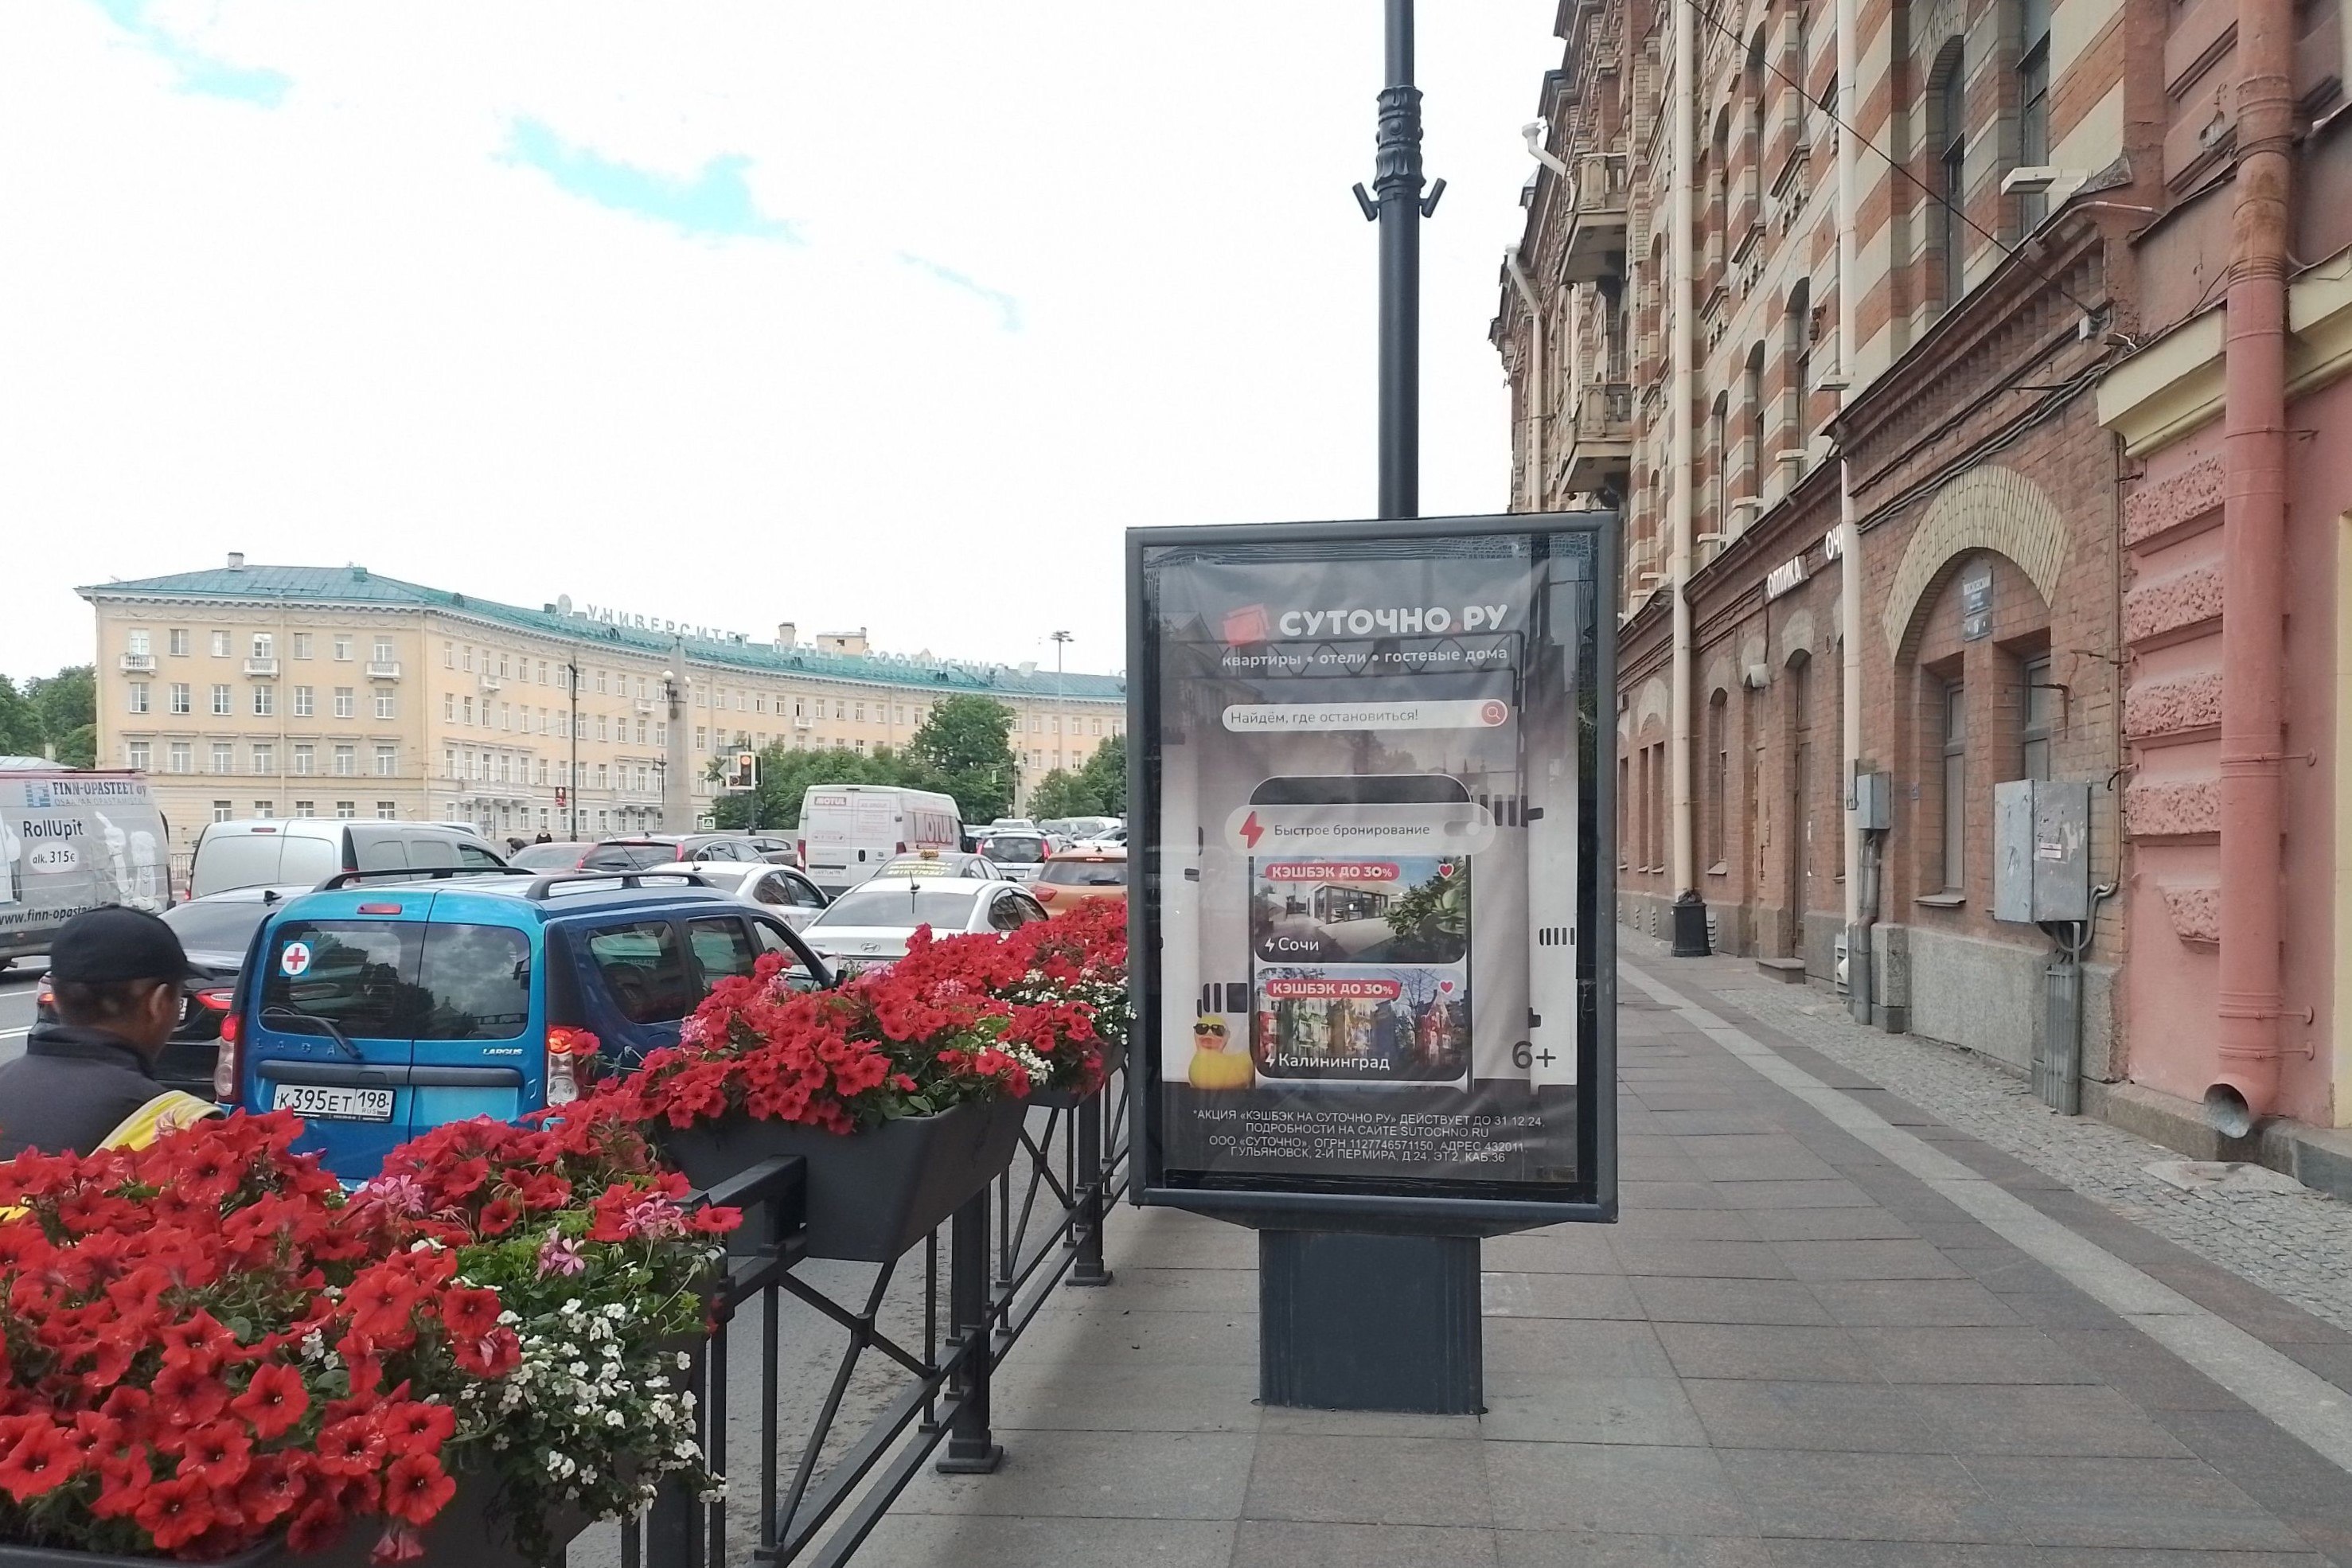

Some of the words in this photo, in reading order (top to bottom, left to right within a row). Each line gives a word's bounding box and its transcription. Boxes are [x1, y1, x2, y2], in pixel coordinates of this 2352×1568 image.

[1768, 556, 1802, 598] ОПТИКА
[587, 603, 750, 649] УНИВЕРСИТЕТ
[1279, 604, 1508, 636] СУТОЧНО.РУ
[1222, 654, 1301, 668] квартиры
[1320, 652, 1367, 664] отели
[1385, 649, 1460, 662] гостевые
[1465, 648, 1508, 661] дома
[1231, 711, 1289, 726] Найдём,
[1293, 712, 1315, 725] где
[1320, 709, 1418, 722] остановиться!
[53, 782, 134, 795] FINN-OPASTEET
[24, 818, 83, 841] RollUpit
[914, 812, 953, 845] MOTUL
[1274, 825, 1329, 837] Быстрое
[1333, 824, 1430, 837] бронирование
[33, 854, 47, 864] alk.
[49, 850, 76, 863] 315€
[1272, 866, 1335, 878] КЭШБЭК
[1339, 866, 1360, 879] ДО
[1363, 866, 1392, 877] 30%
[0, 906, 93, 925] ww.finn-opaste
[1277, 937, 1319, 951] Сочи
[1272, 983, 1336, 995] КЭШБЭК
[1340, 983, 1361, 996] ДО
[1364, 984, 1394, 995] 30%
[1278, 1053, 1391, 1071] Калининград
[1511, 1040, 1557, 1069] 6+
[358, 1091, 387, 1108] 198
[1241, 1110, 1294, 1121] «КЭШБЭК
[1297, 1112, 1313, 1121] НА
[1399, 1112, 1470, 1125] ДЕЙСТВУЕТ
[1473, 1116, 1492, 1126] ДО
[1246, 1122, 1336, 1134] ПОДРОБНОСТИ
[1338, 1125, 1355, 1135] НА
[1358, 1124, 1398, 1136] САЙТЕ
[1209, 1135, 1236, 1145] ООО
[1314, 1137, 1346, 1148] ОГРН
